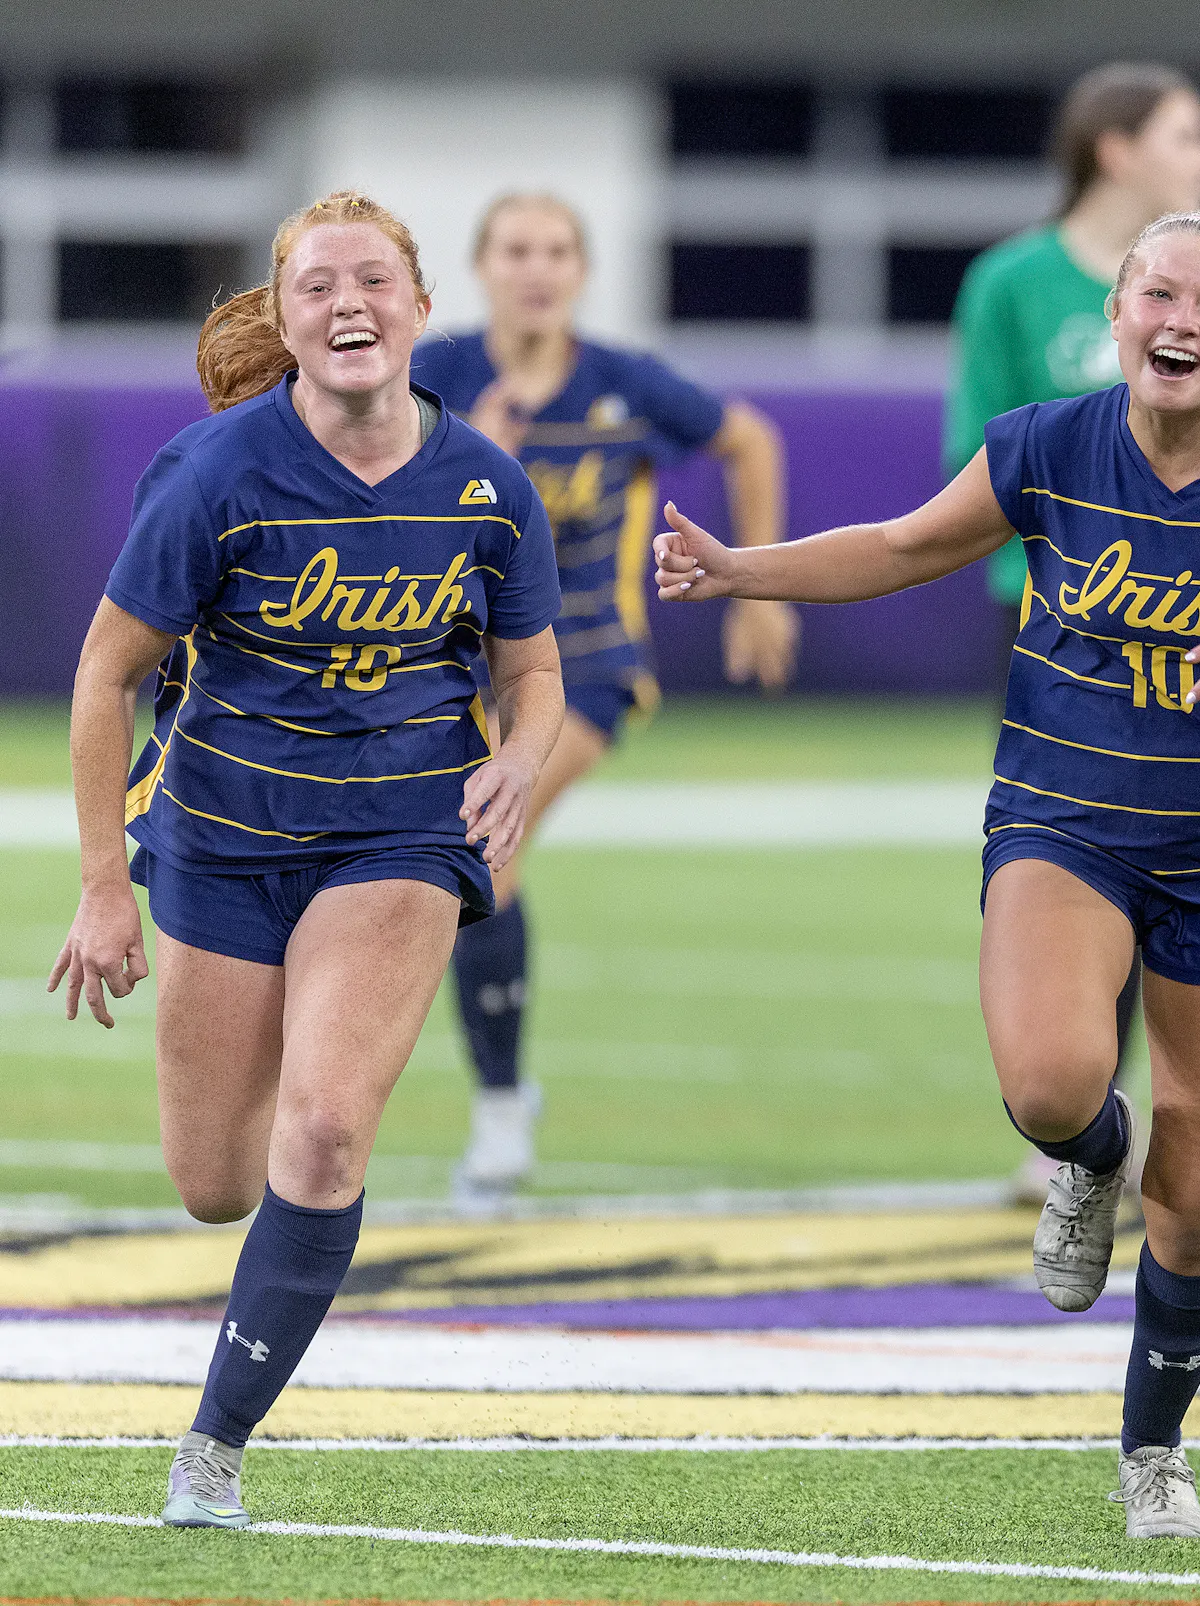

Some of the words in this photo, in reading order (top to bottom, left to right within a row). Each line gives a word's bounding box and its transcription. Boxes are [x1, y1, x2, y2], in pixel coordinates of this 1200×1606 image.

[258, 546, 472, 632] Irish
[321, 643, 402, 692] 10
[1122, 641, 1194, 714] 10
